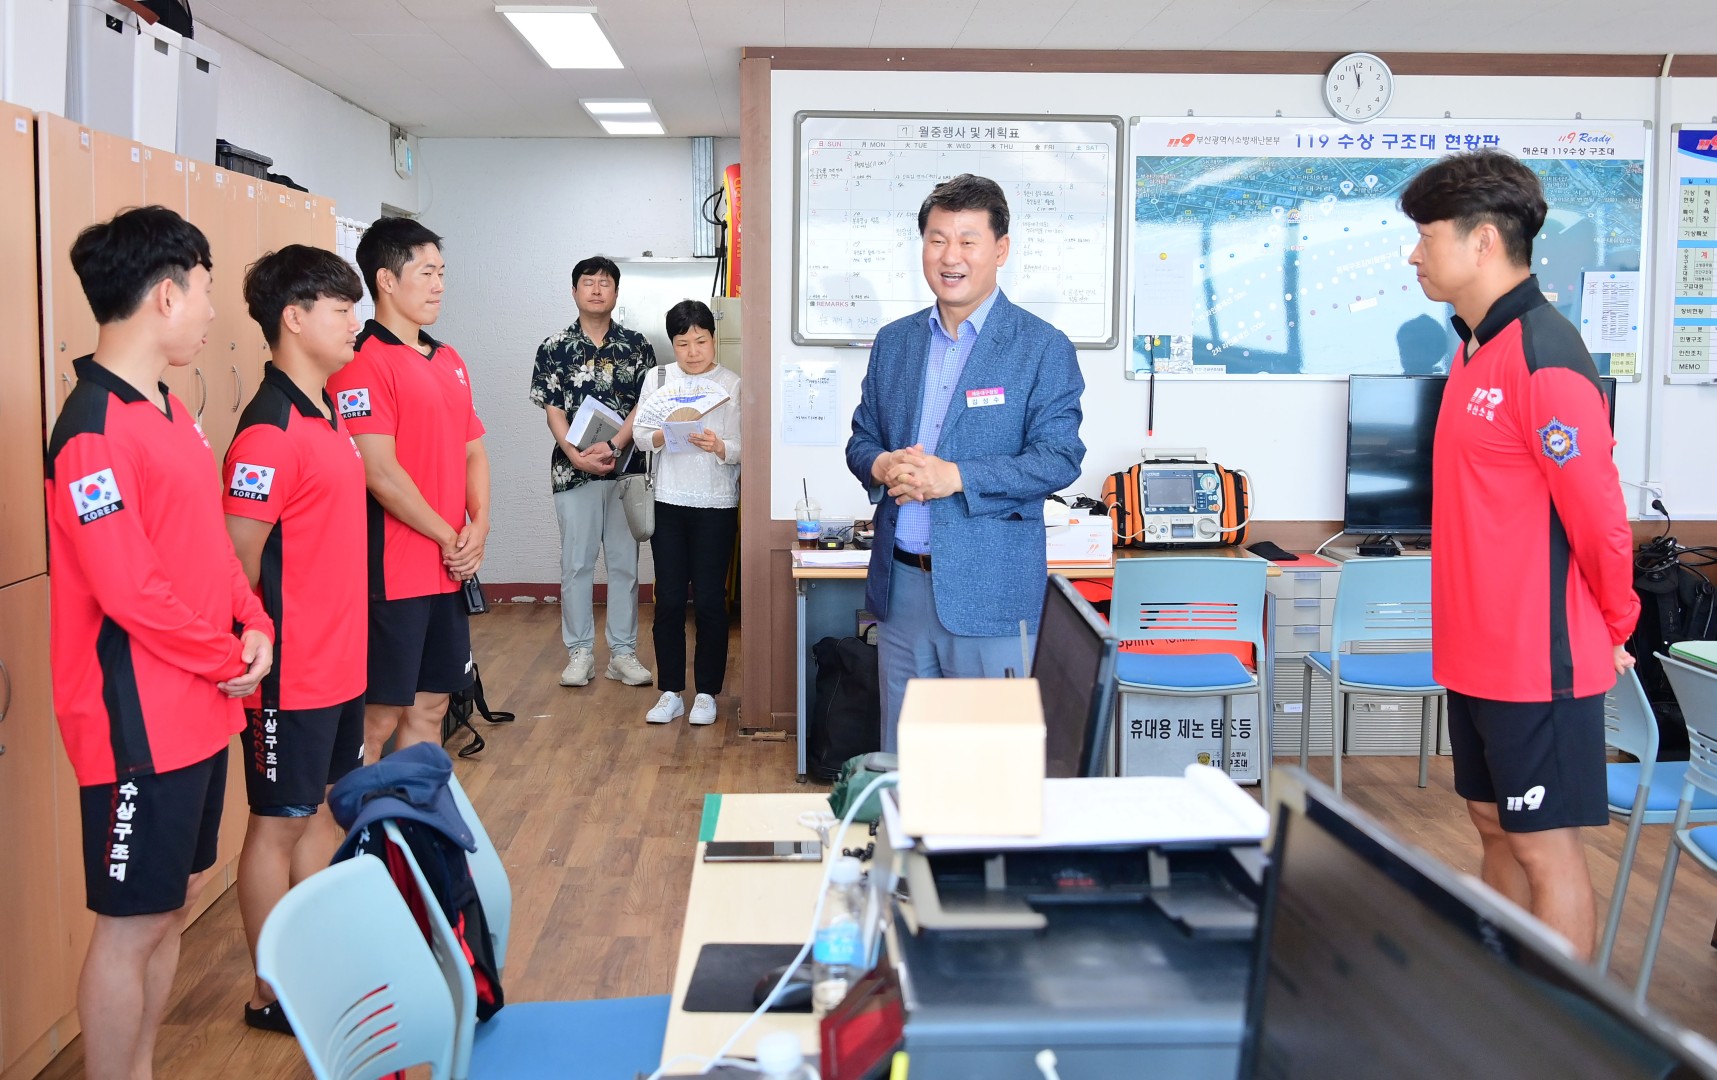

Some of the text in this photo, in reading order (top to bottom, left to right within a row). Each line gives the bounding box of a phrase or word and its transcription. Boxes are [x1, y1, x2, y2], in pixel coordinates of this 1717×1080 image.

[918, 126, 966, 138] 월중행사
[970, 127, 980, 138] 및
[984, 127, 1020, 139] 계획표
[1167, 133, 1280, 147] 119 부산광역시소방재난본부
[1579, 133, 1611, 144] Ready
[1296, 134, 1500, 150] 119 수상 구조대 현황판
[1522, 147, 1548, 155] 해운대
[1552, 147, 1586, 156] 119수상
[1470, 387, 1504, 409] 119
[343, 411, 367, 419] KOREA
[1466, 403, 1494, 422] 부산소방
[233, 490, 264, 500] KOREA
[84, 504, 119, 523] KOREA
[1130, 719, 1171, 739] 휴대용
[1177, 719, 1204, 739] 제논
[1507, 785, 1545, 811] 119
[109, 782, 138, 882] 수상구조대
